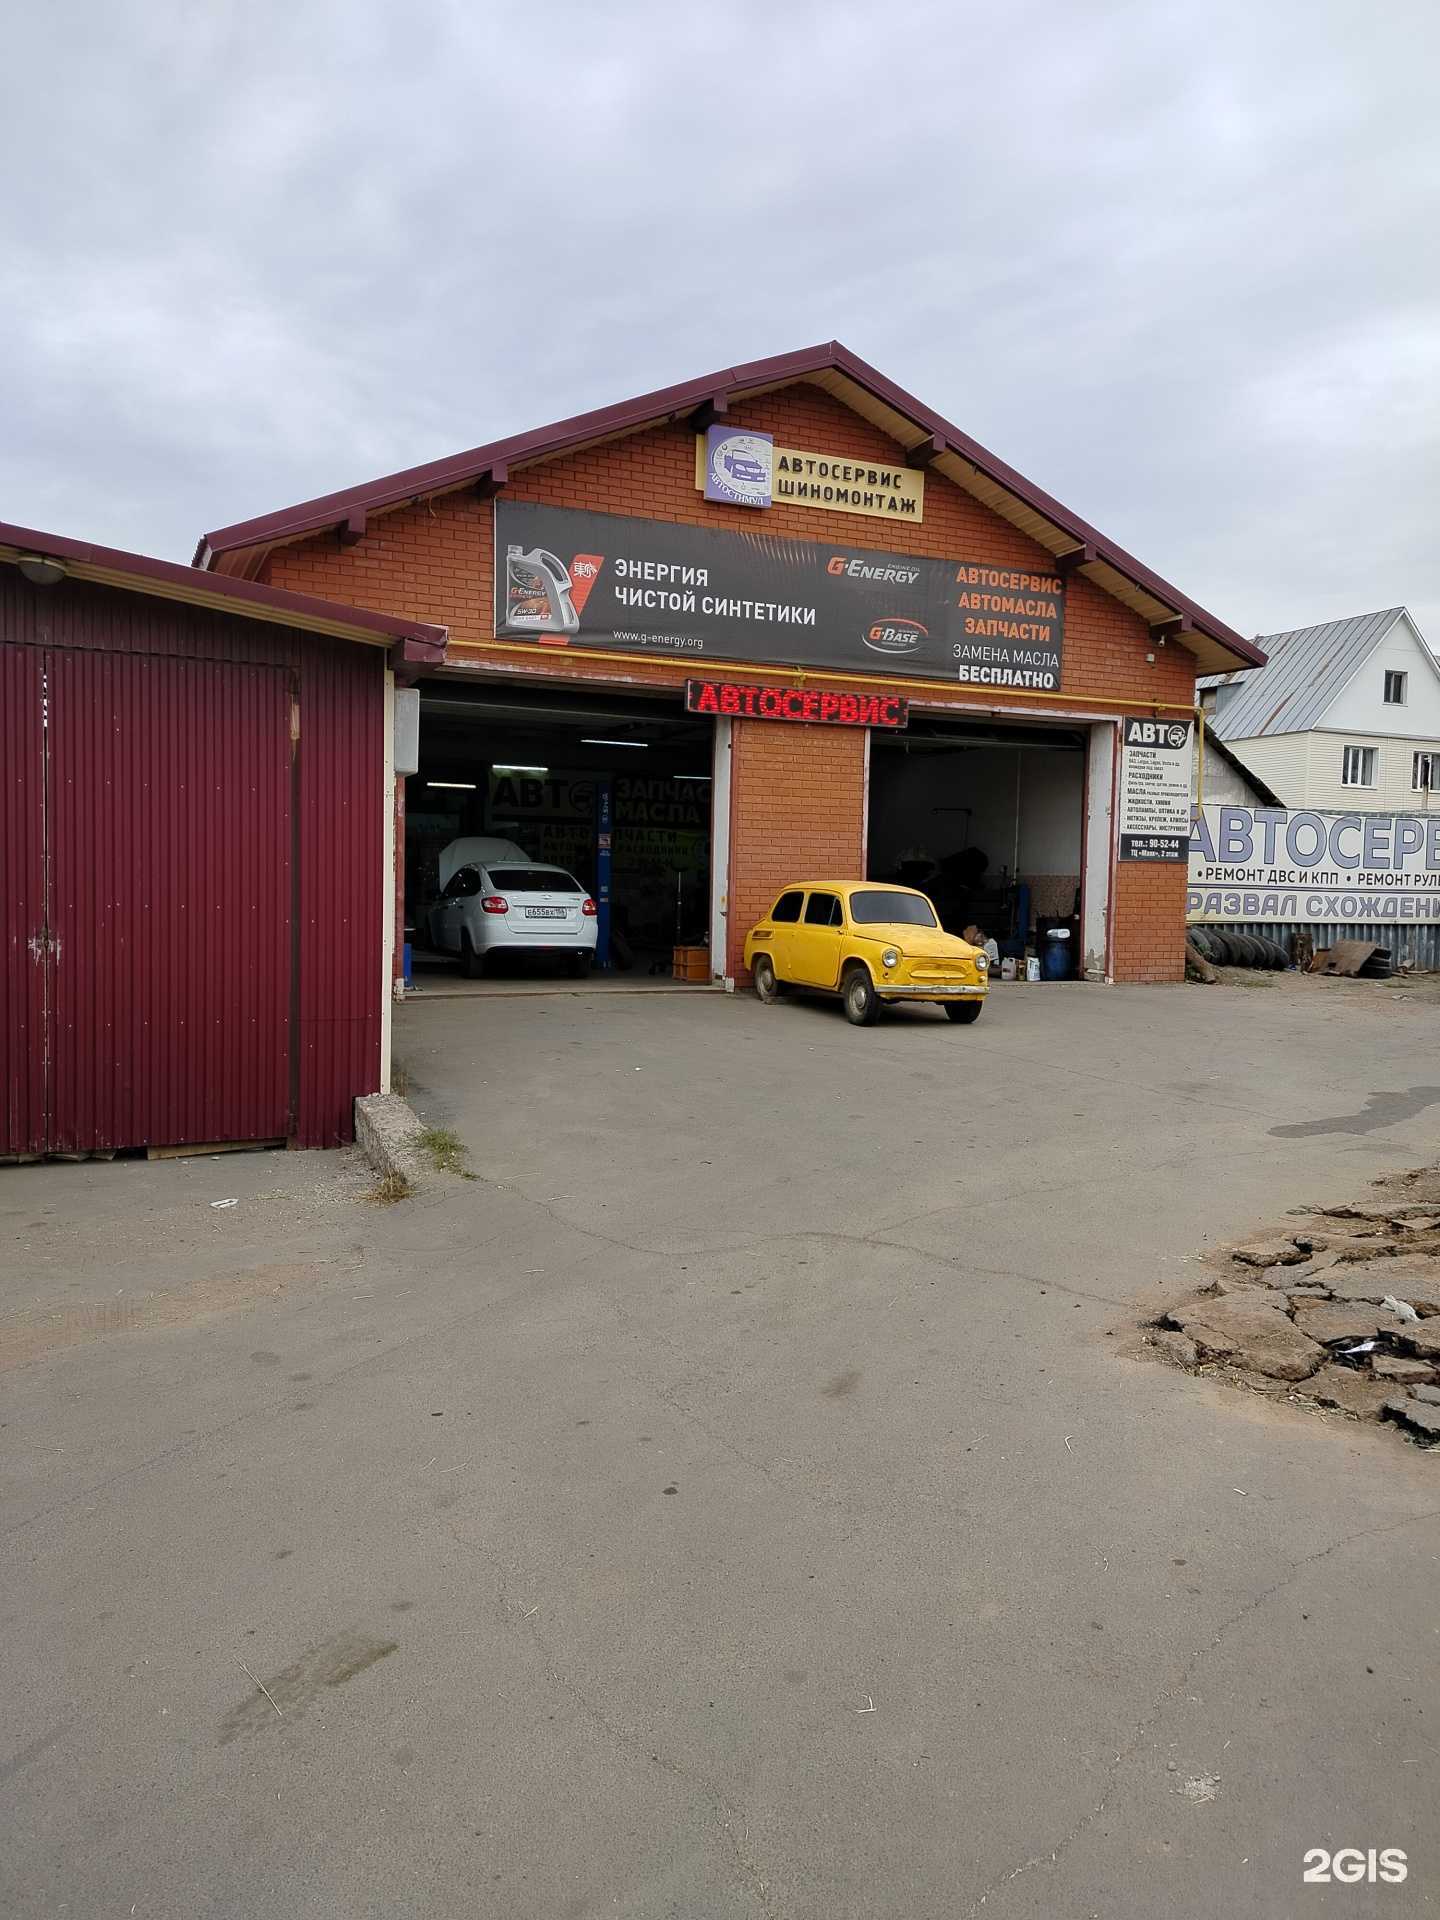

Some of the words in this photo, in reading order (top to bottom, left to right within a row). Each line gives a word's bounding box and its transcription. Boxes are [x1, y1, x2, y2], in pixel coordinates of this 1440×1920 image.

[778, 455, 903, 489] АВТОСЕРВИС
[778, 479, 917, 514] ШИНОМОНТАЖ
[614, 558, 709, 587] ЭНЕРГИЯ
[956, 566, 1063, 594] АВТОСЕРВИС
[615, 586, 695, 613] ЧИСТОЙ
[702, 596, 817, 626] СИНТЕТИКИ
[958, 592, 1057, 619] АВТОМАСЛА
[613, 629, 704, 649] www.g-energy.org
[965, 617, 1050, 641] ЗАПЧАСТИ
[952, 643, 1010, 663] ЗАМЕНА
[1013, 649, 1059, 668] МАСЛА
[959, 664, 1054, 688] БЕСПЛАТНО
[698, 683, 900, 725] АВТОСЕРВИС
[1128, 771, 1164, 781] РАСХОДНИКИ
[1127, 787, 1146, 796] МАСЛА
[1149, 839, 1179, 849] 90-52-44
[1206, 868, 1264, 881] РЕМОНТ
[1267, 869, 1296, 885] ДВС
[1299, 871, 1308, 883] И
[1311, 872, 1339, 885] КПП
[1357, 873, 1412, 886] РЕМОНТ
[1414, 874, 1440, 887] РУЛ
[1186, 891, 1297, 916] РАЗВАЛ
